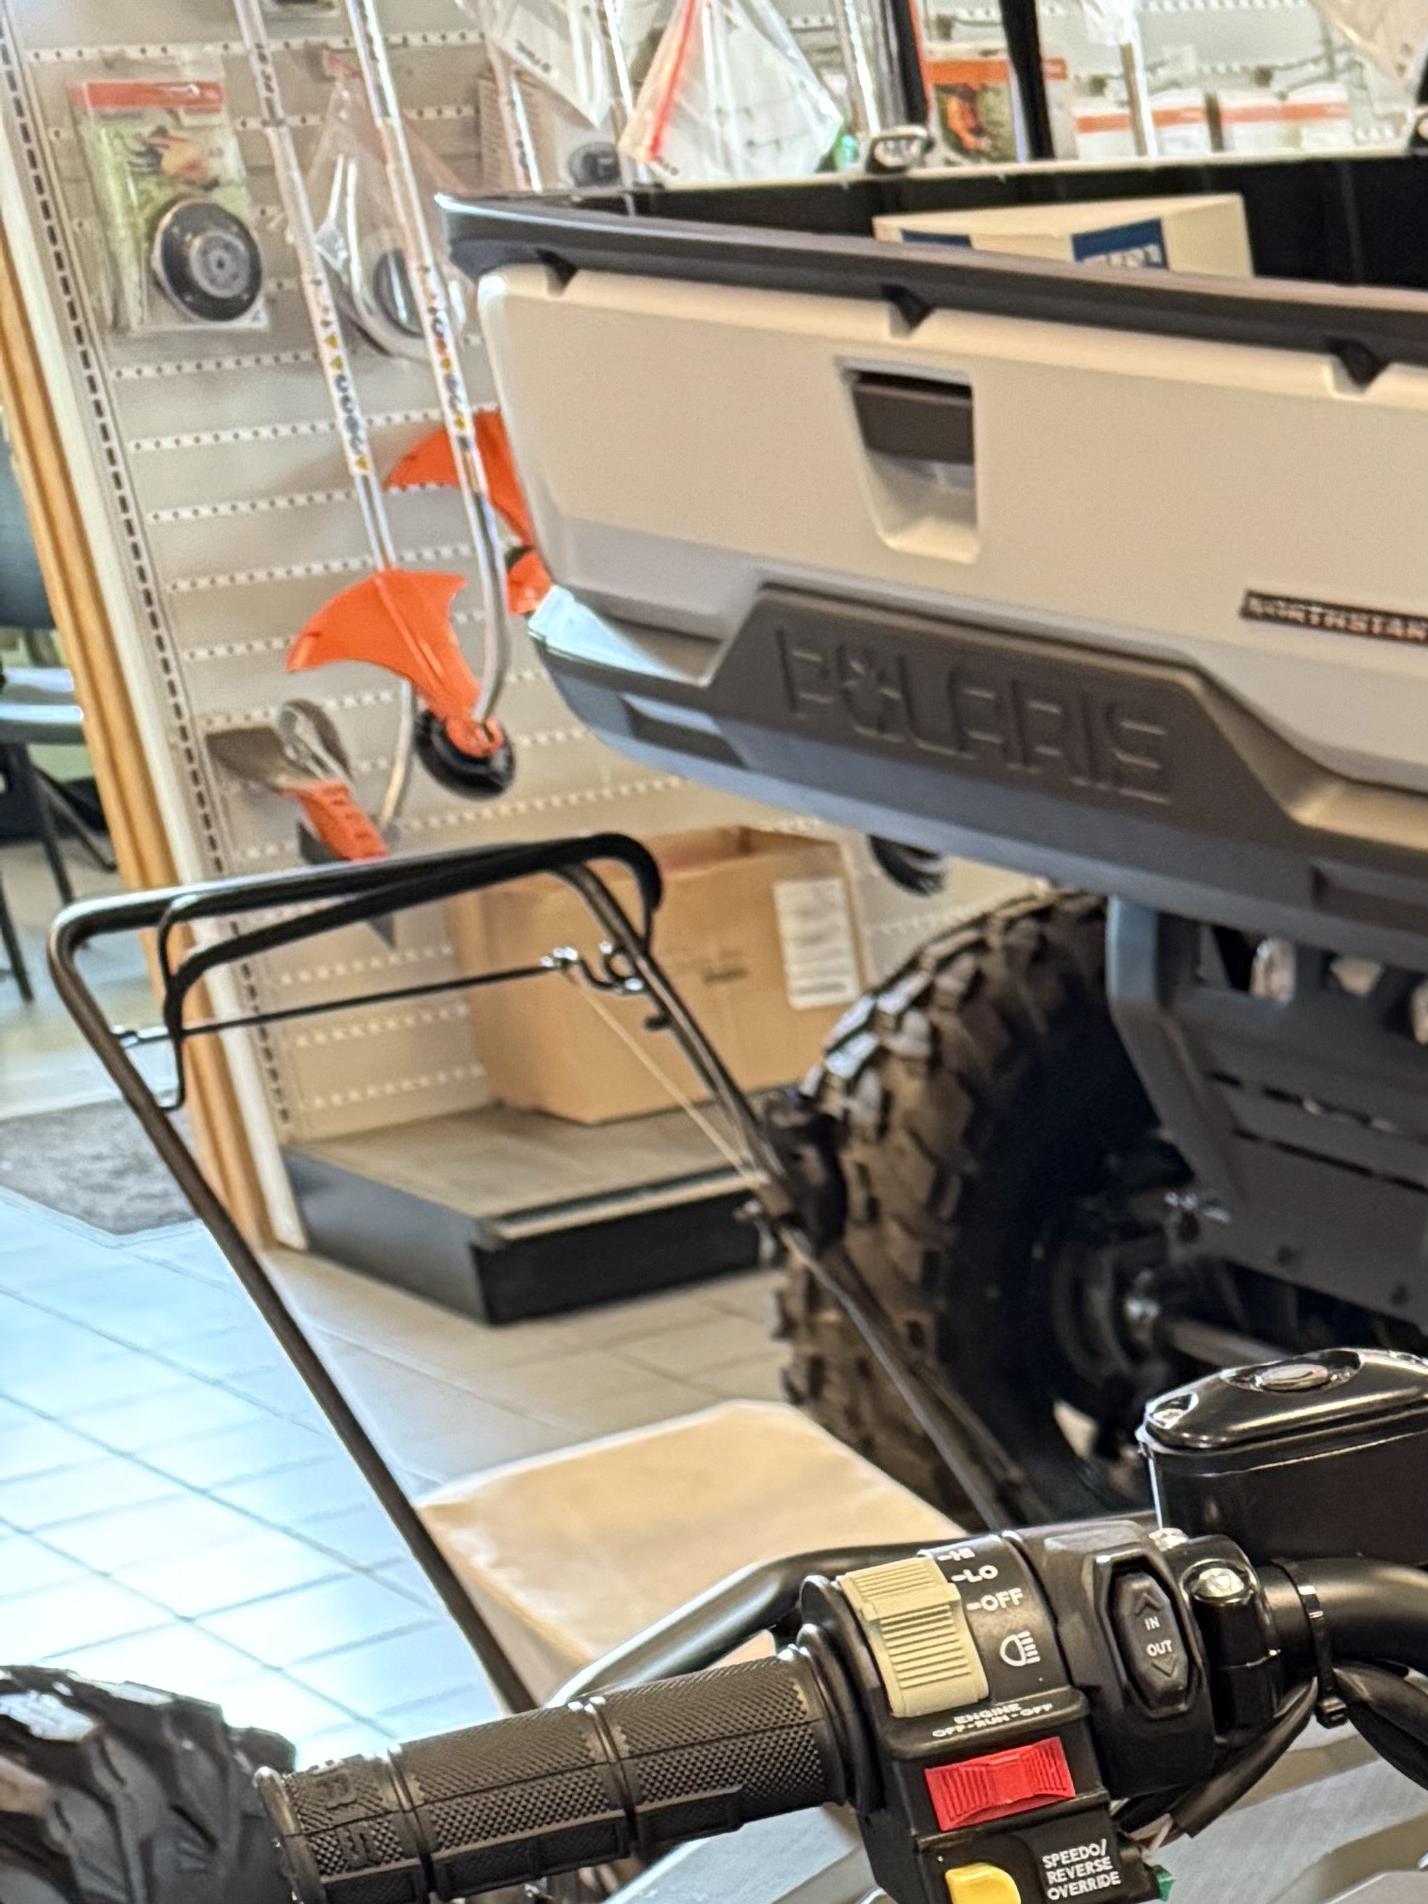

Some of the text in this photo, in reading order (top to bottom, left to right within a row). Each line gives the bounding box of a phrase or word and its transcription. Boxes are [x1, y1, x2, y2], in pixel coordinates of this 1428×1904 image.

[1247, 595, 1428, 642] NORTHSTAR
[776, 629, 1171, 804] POLARIS
[1145, 1617, 1160, 1631] IN
[1147, 1640, 1172, 1656] OUT
[954, 1703, 1022, 1723] ENGINE
[1042, 1838, 1107, 1869] SPEEDO/
[1046, 1856, 1114, 1885] REVERSE
[1047, 1871, 1121, 1900] OVERRIDE
